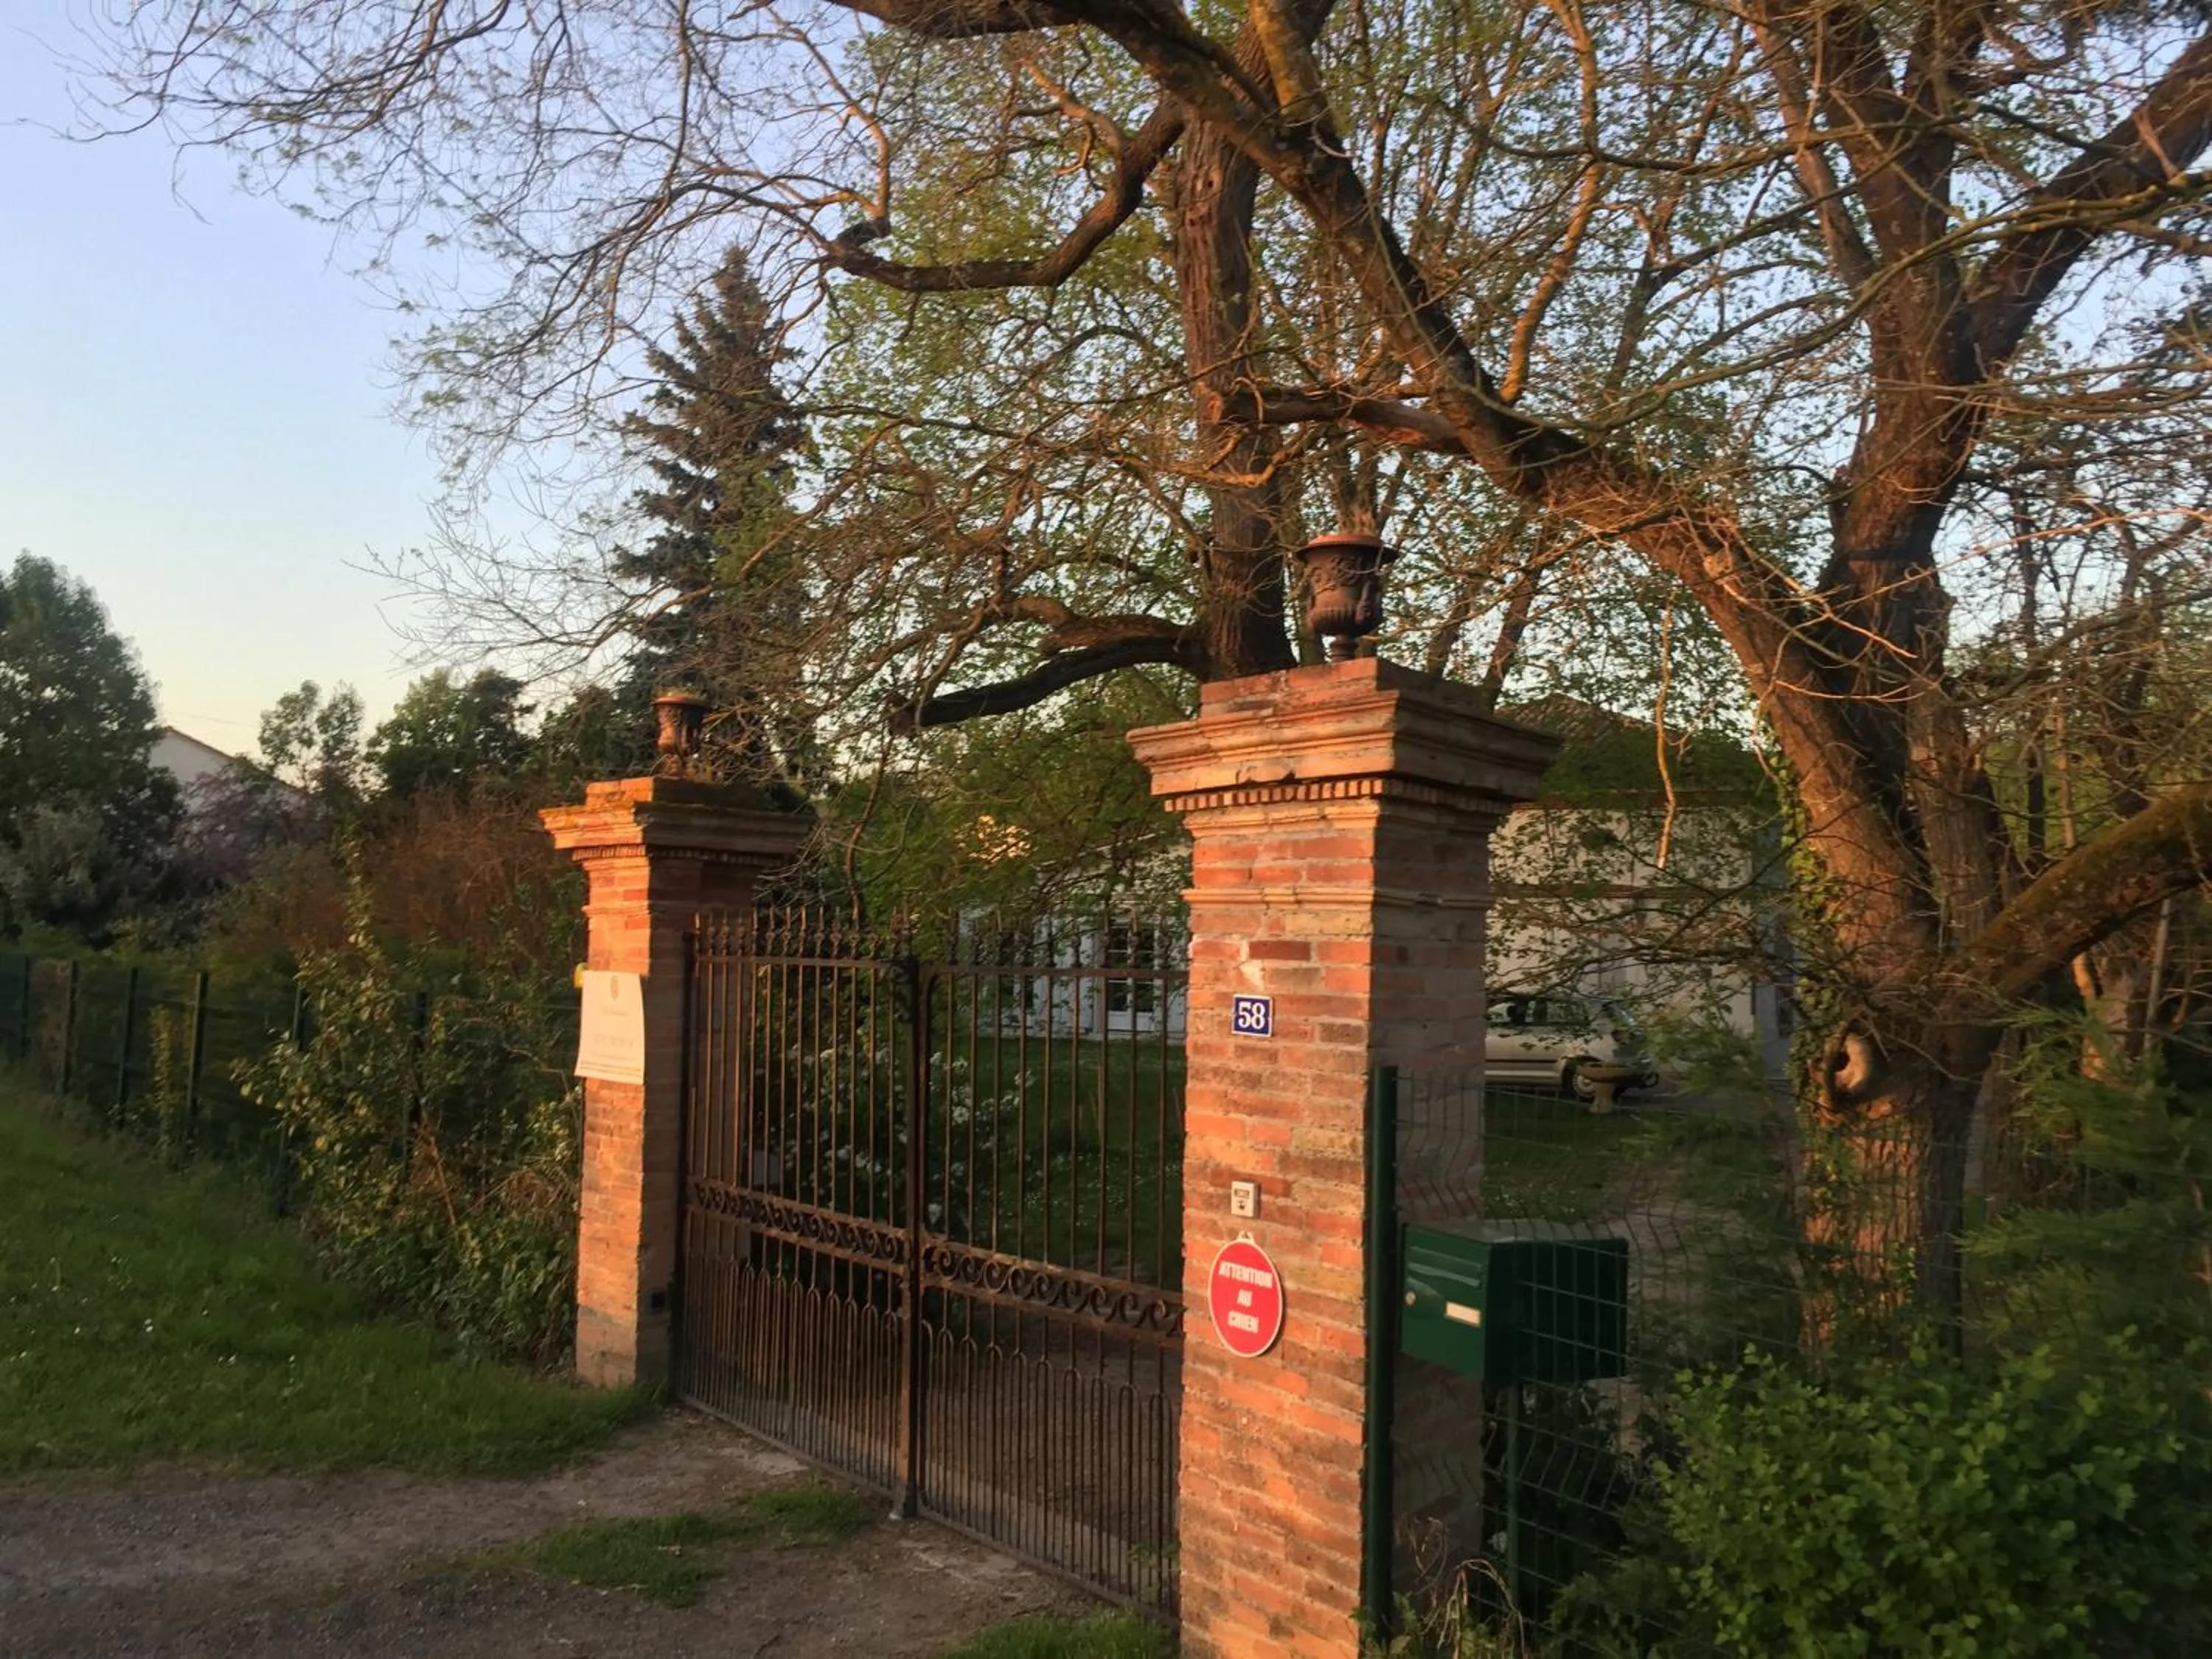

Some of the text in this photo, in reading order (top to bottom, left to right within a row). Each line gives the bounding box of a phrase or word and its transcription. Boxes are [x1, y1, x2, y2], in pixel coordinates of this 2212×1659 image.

[1238, 1001, 1266, 1029] 58
[1218, 1261, 1273, 1289] ATTENTION
[1237, 1288, 1253, 1307] AU
